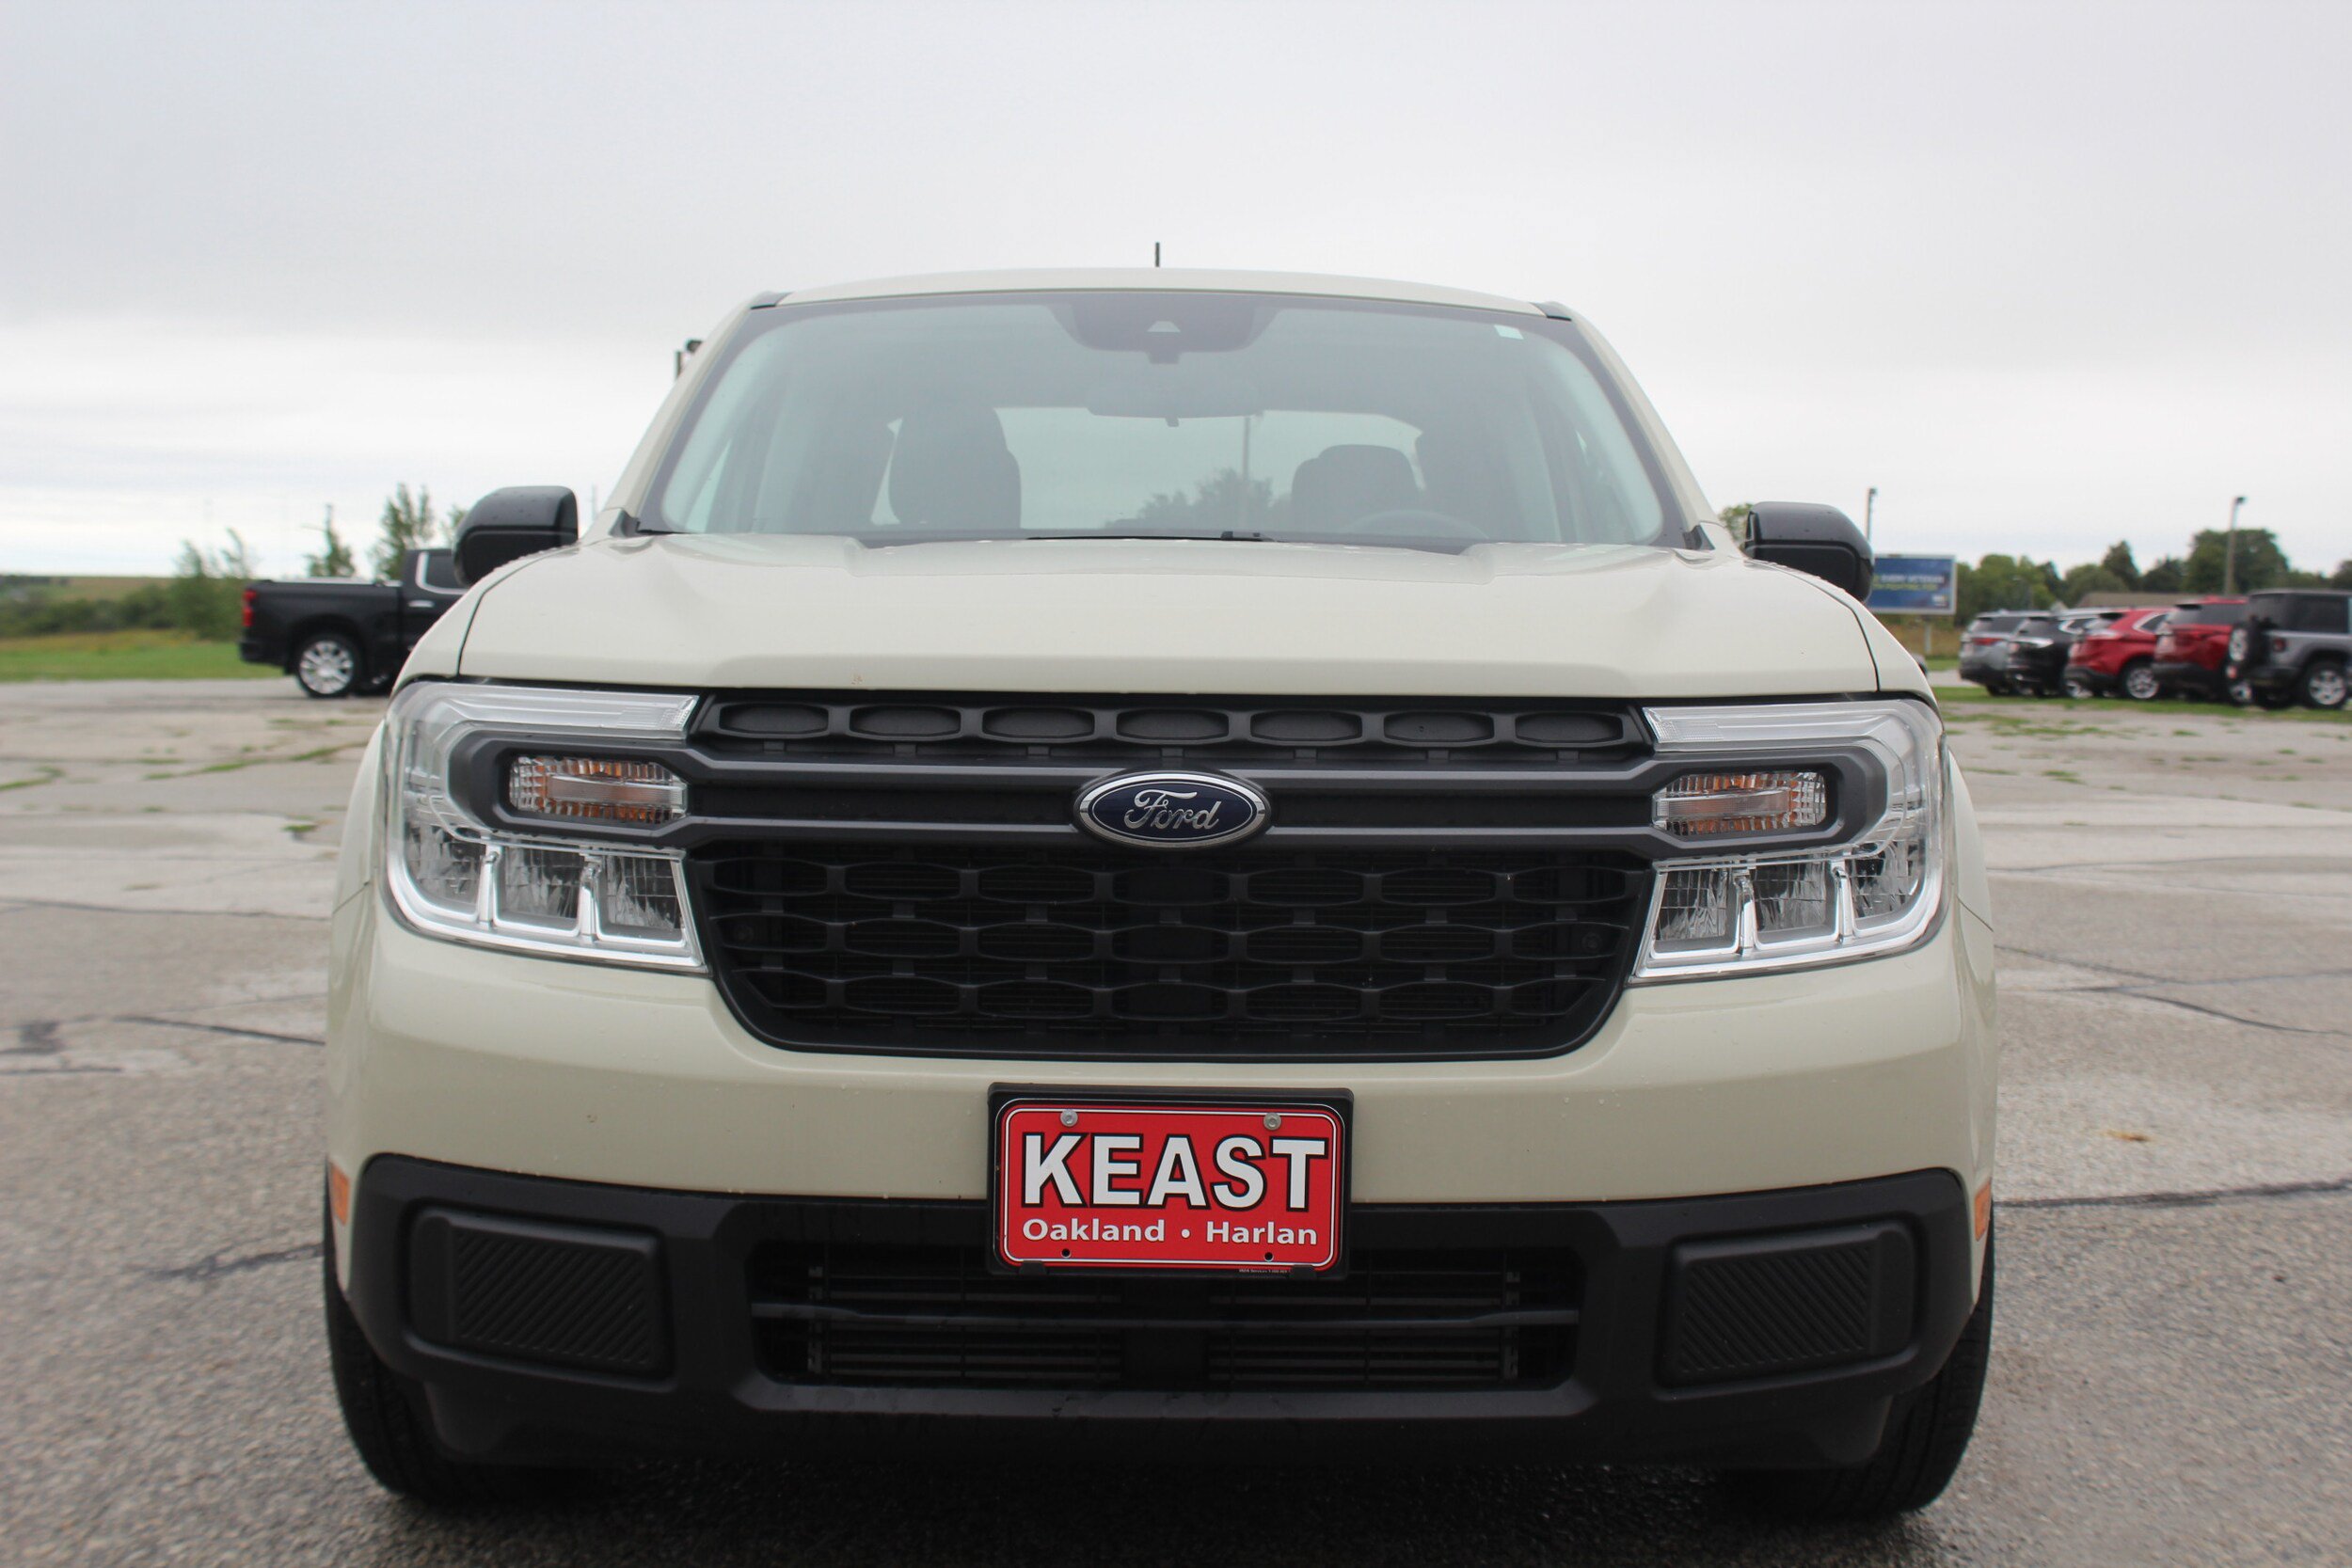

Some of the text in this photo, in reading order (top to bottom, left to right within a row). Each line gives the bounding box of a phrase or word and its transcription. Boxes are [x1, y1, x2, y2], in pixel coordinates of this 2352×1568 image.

[1124, 789, 1221, 829] Ford
[1022, 1132, 1328, 1212] KEAST
[1022, 1218, 1317, 1244] Oakland Harlan
